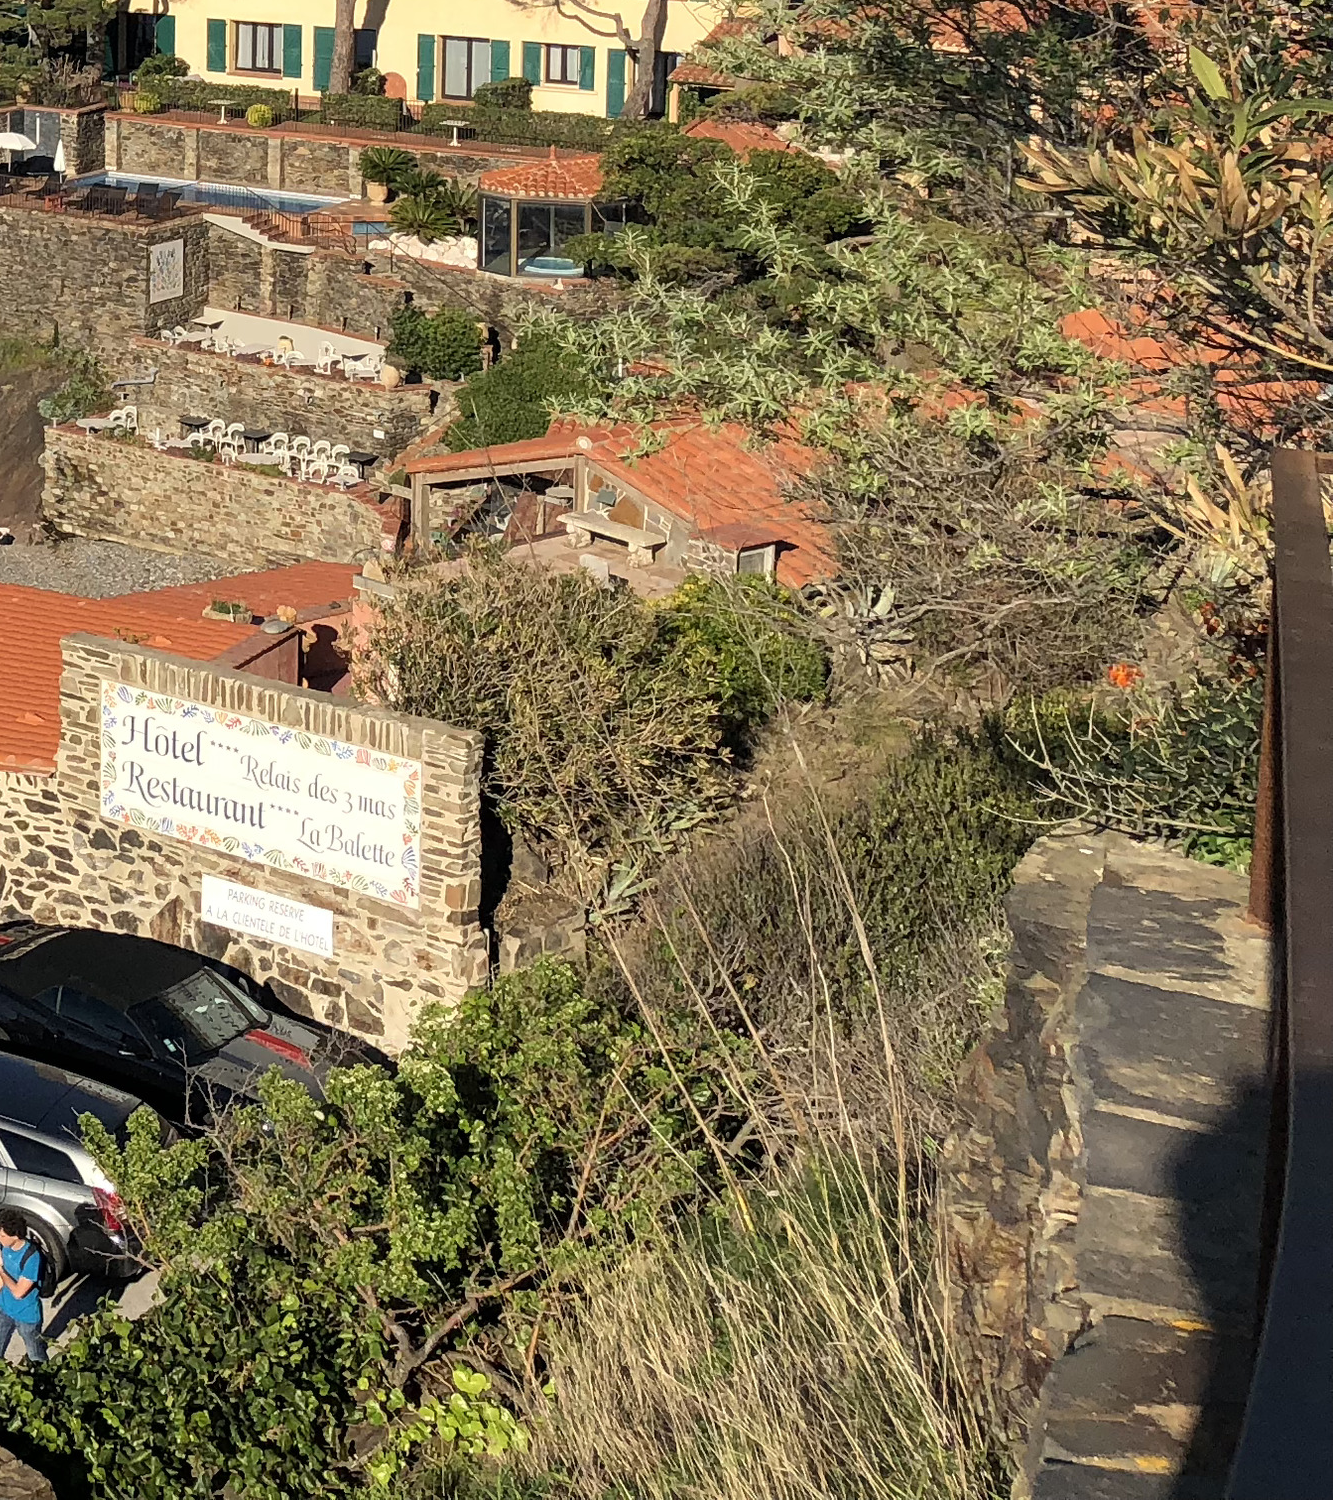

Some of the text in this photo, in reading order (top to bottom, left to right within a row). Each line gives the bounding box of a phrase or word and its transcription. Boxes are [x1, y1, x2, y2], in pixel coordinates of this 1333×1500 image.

[121, 715, 397, 820] Hôtel Relais des 3 mas
[121, 760, 395, 868] Restaurant La Balette
[205, 905, 329, 952] A LA CLIENTELE DE L'HOTEL
[227, 888, 305, 923] PARKING RESERVE
